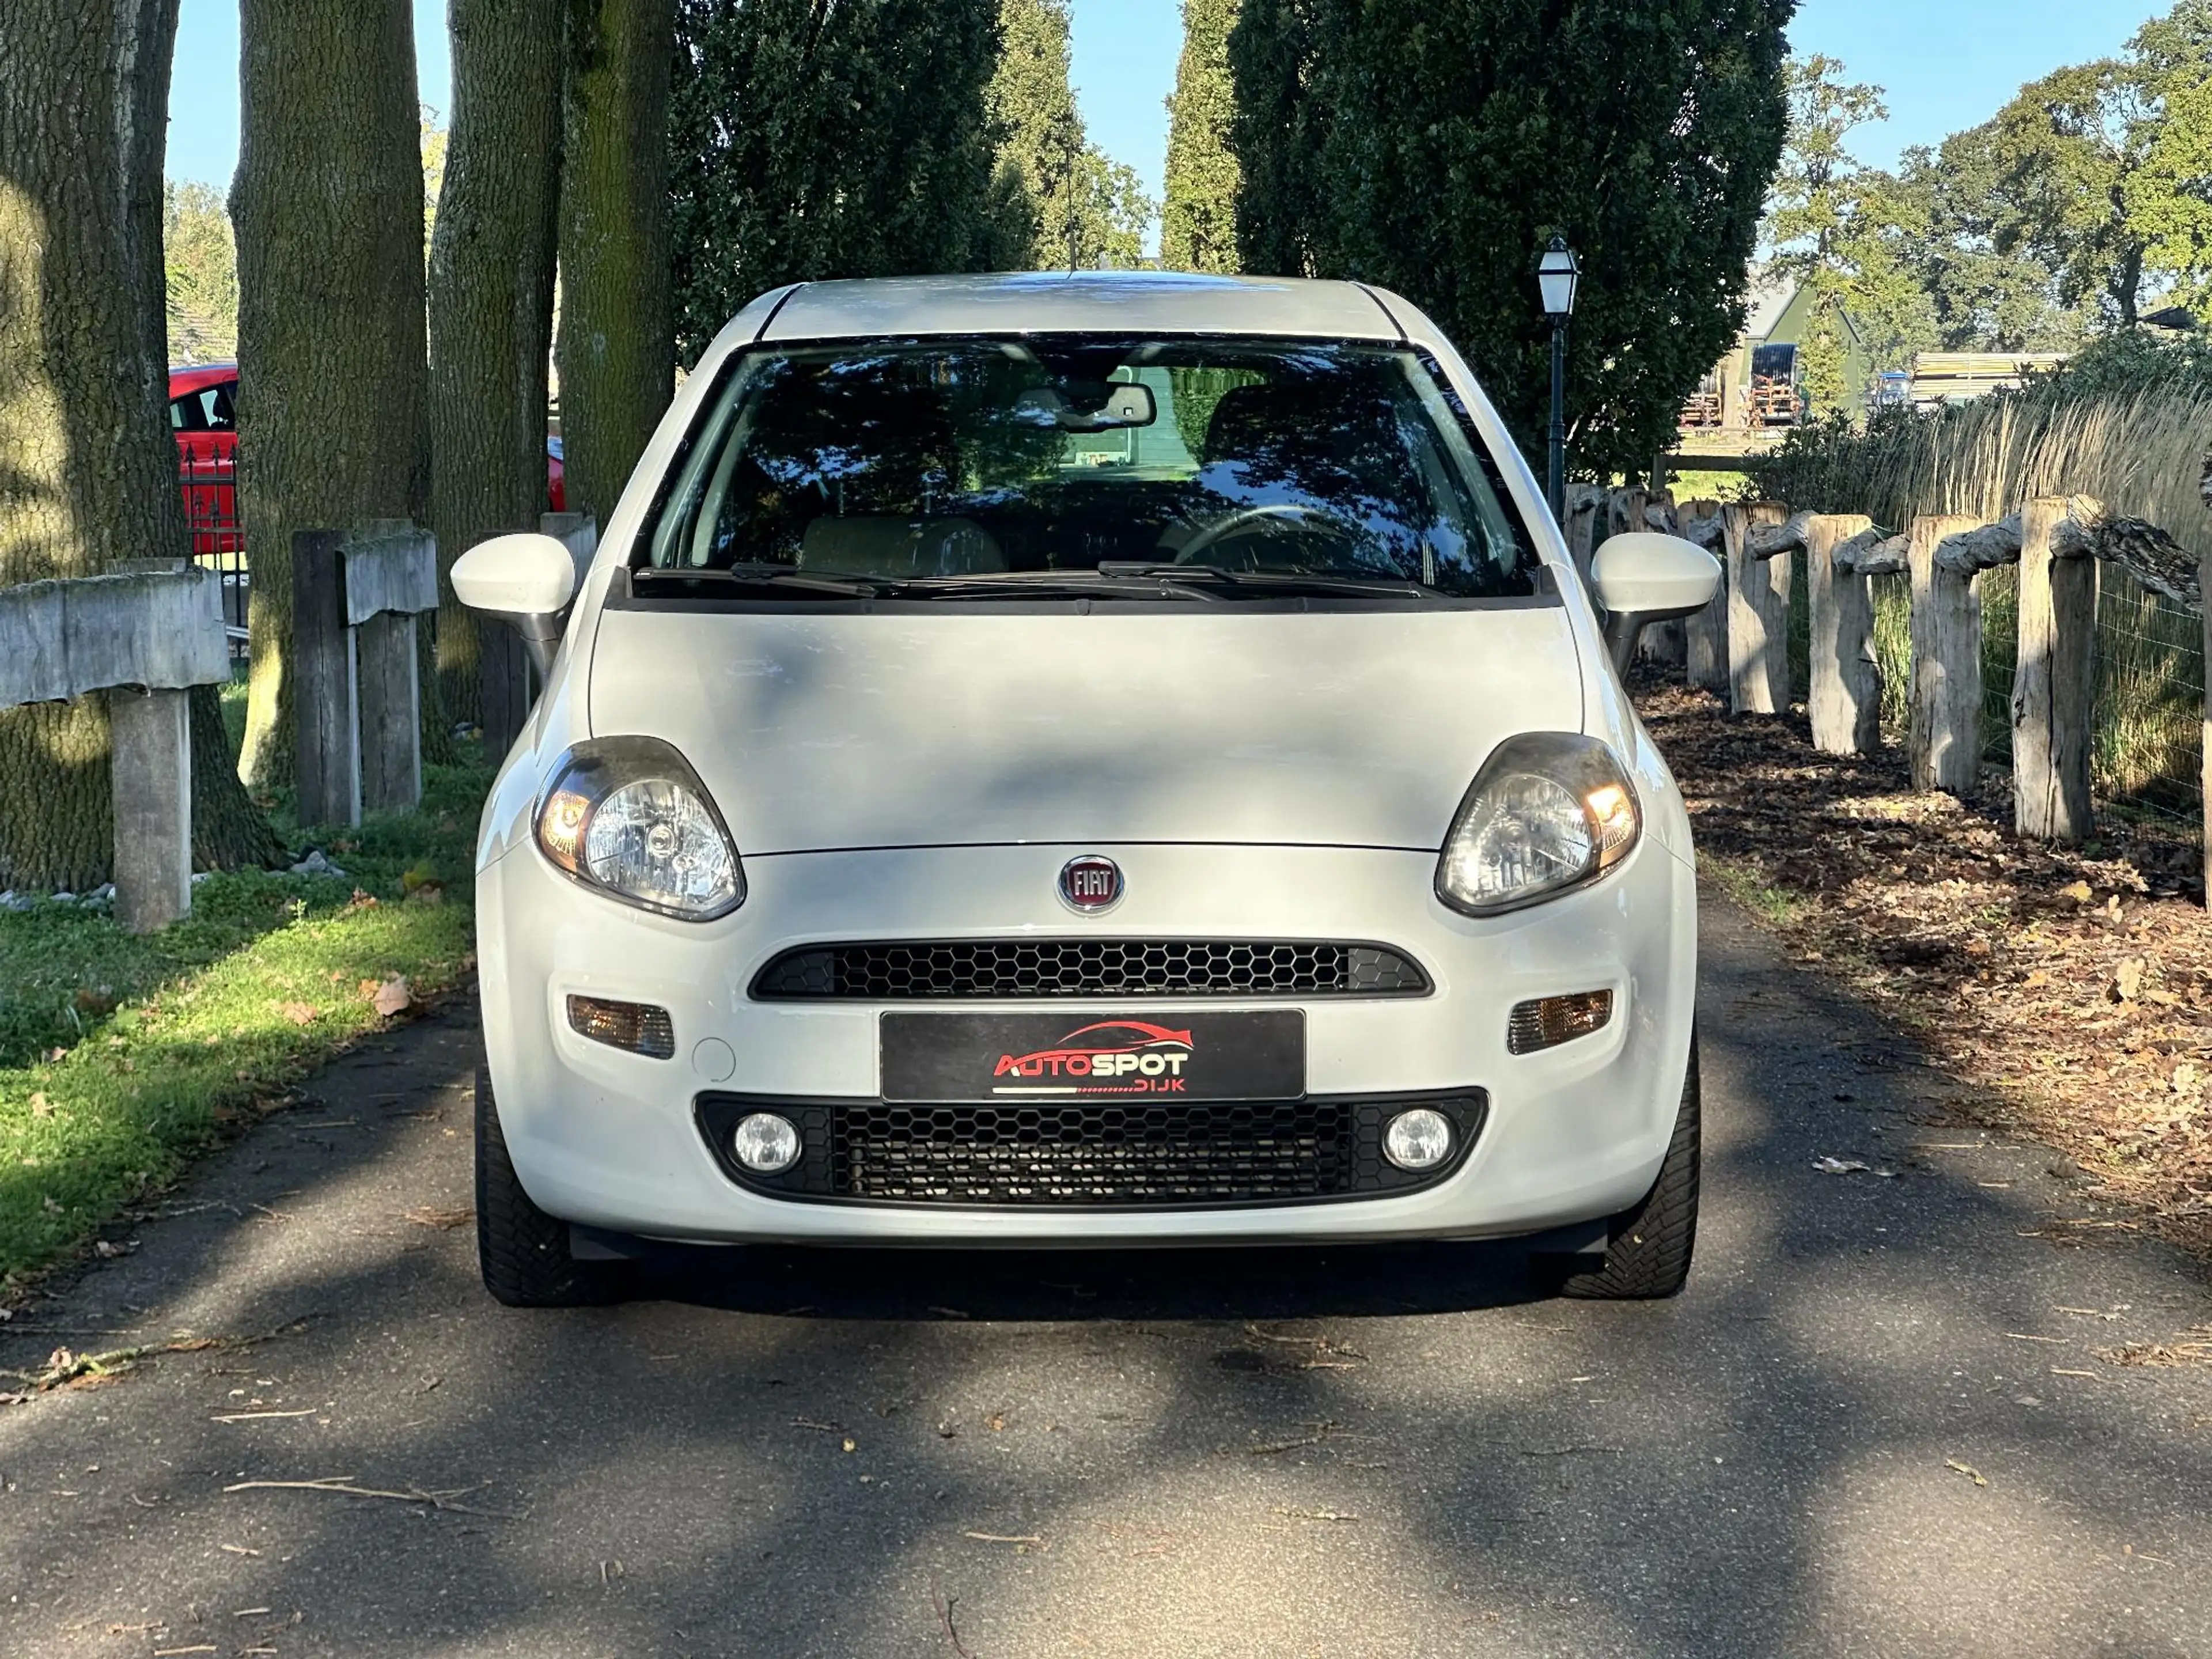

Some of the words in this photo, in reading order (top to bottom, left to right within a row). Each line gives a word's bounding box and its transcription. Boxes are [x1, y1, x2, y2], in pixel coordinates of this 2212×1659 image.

[1073, 870, 1111, 896] FIAT
[994, 1053, 1188, 1077] AUTOSPOT
[1134, 1078, 1185, 1092] DIJK
